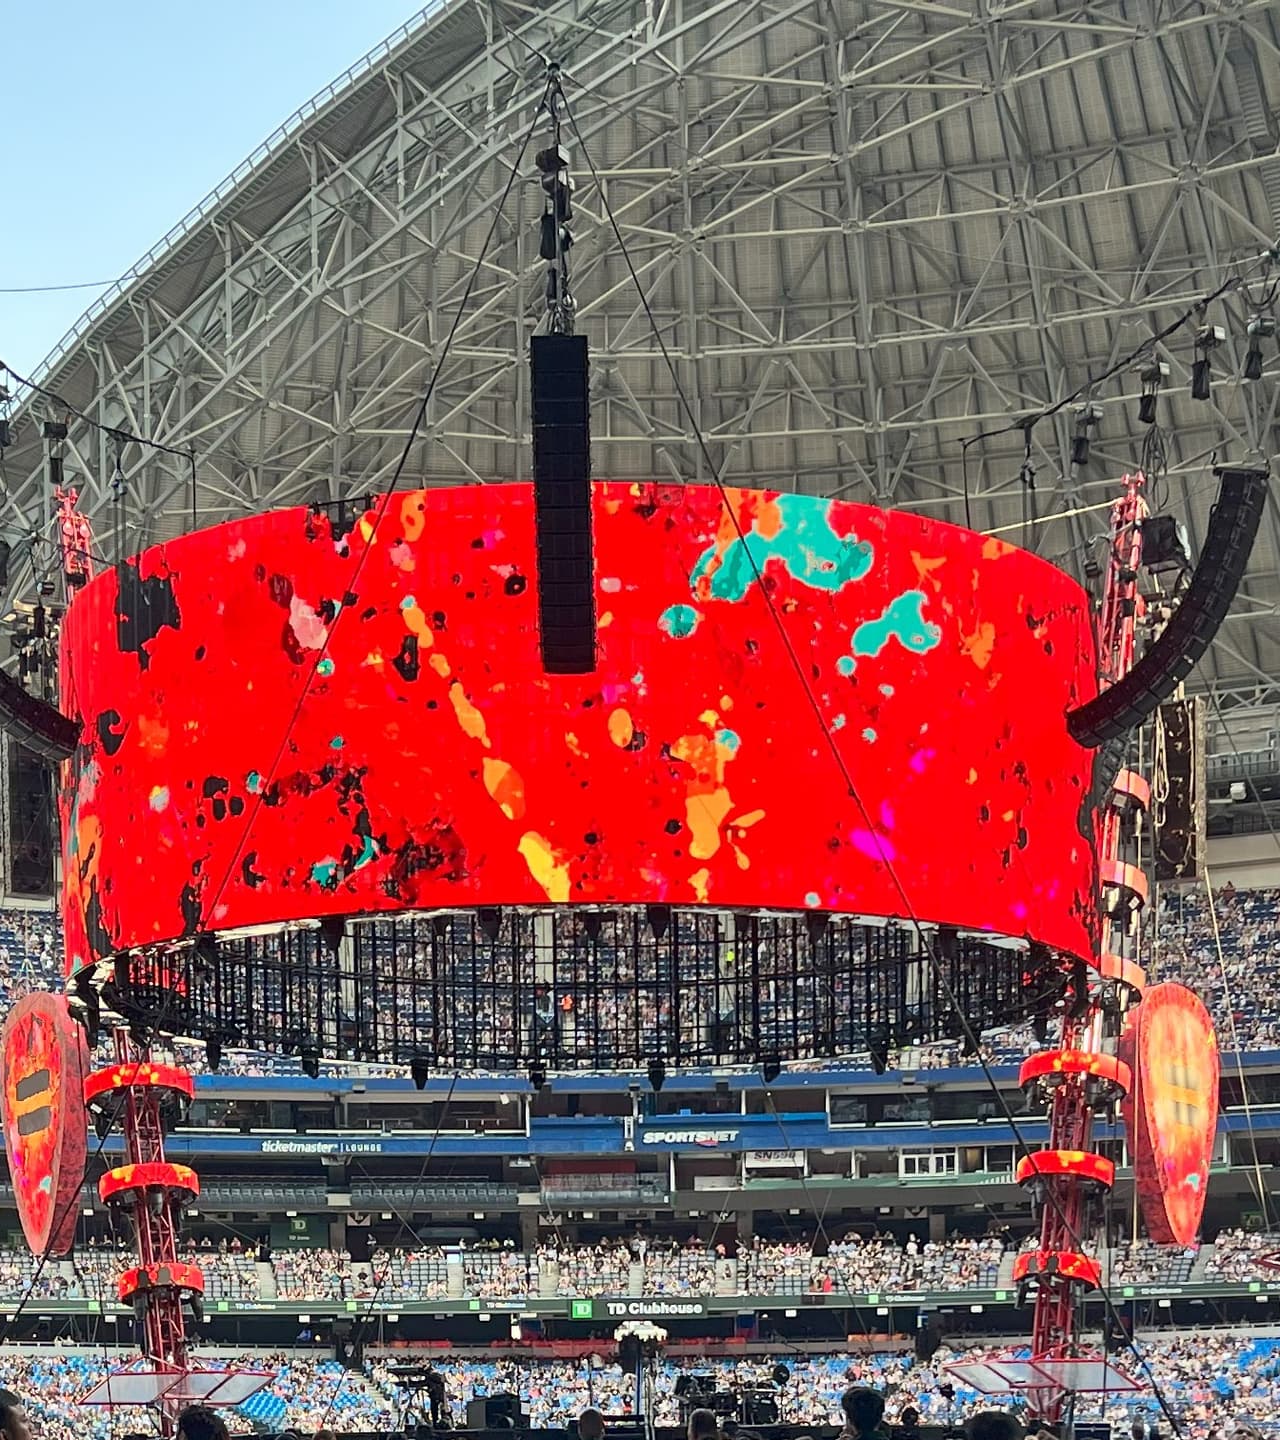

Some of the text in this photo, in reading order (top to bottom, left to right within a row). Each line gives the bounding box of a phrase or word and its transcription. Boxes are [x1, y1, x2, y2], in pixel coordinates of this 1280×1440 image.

[642, 1130, 740, 1144] SPORTSNET
[262, 1140, 381, 1152] ticketmaster LOUNGE
[607, 1302, 703, 1315] TD Clubhouse
